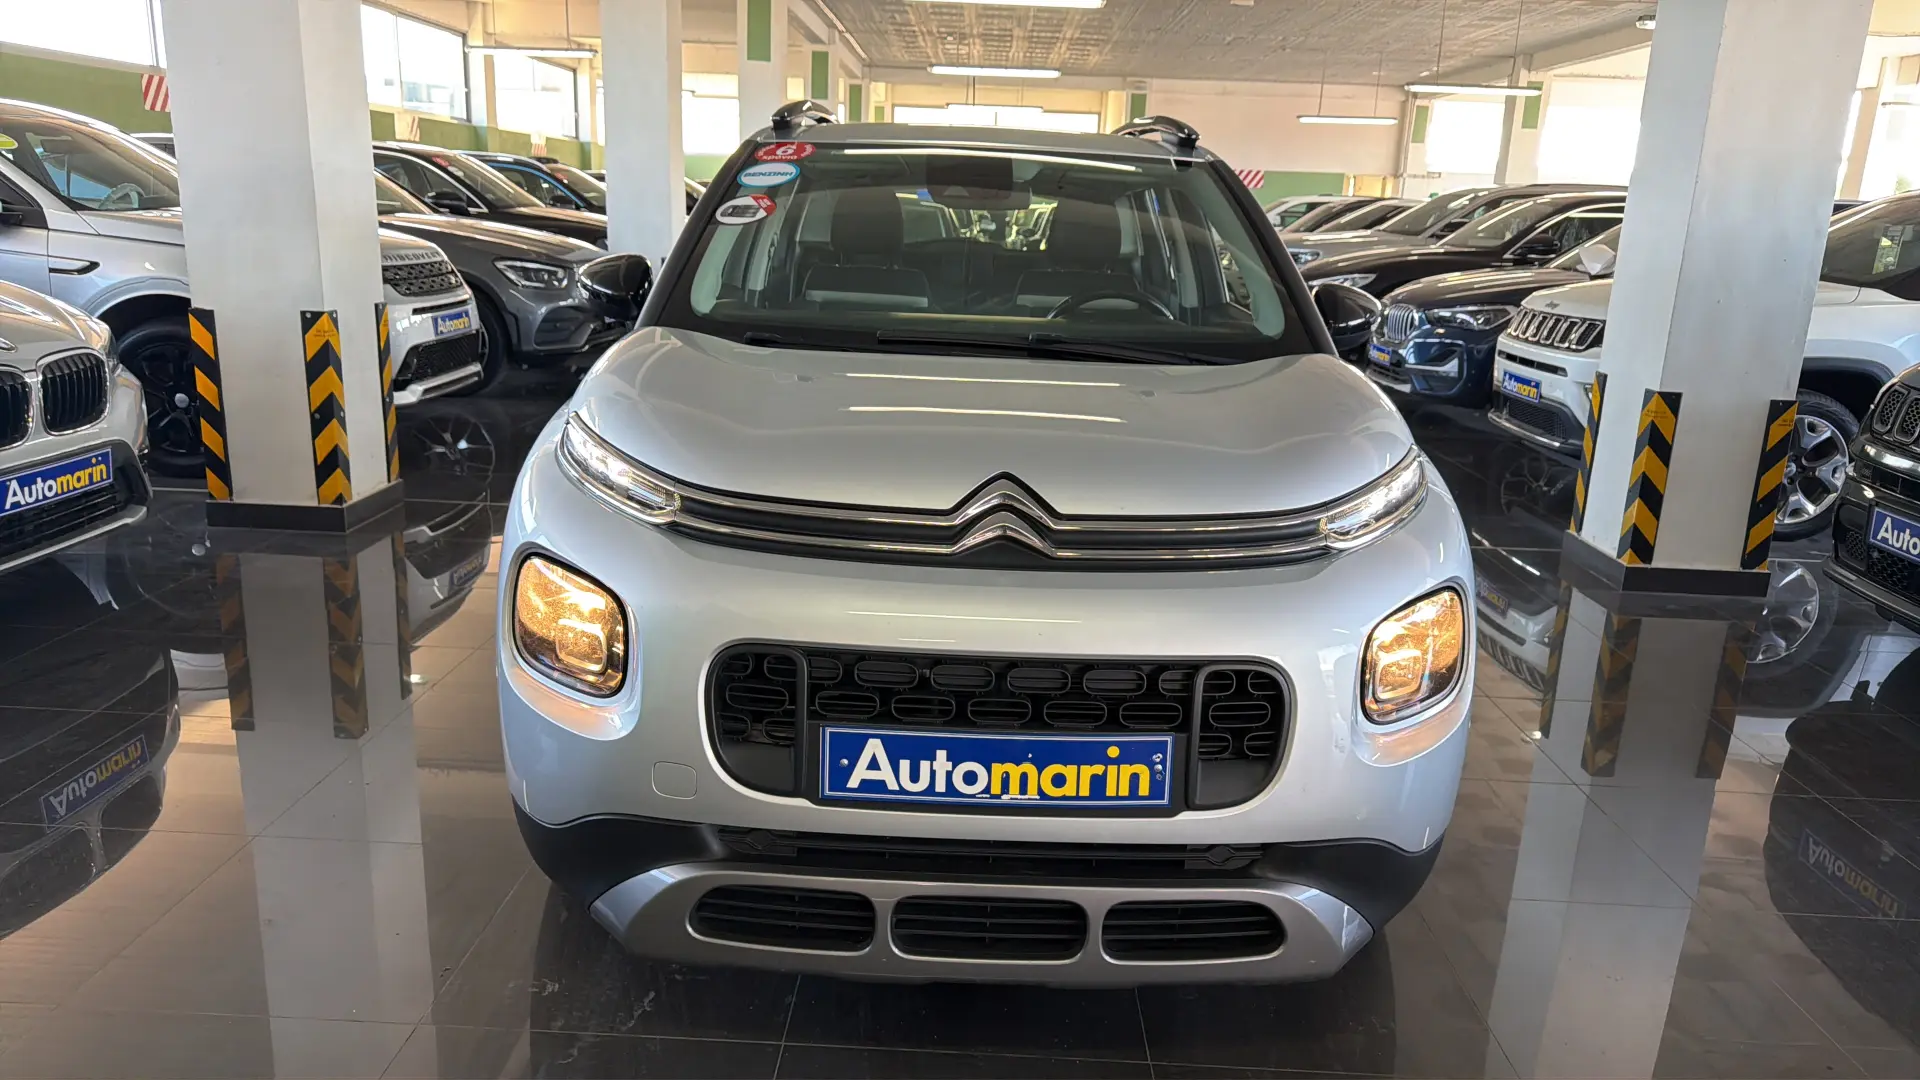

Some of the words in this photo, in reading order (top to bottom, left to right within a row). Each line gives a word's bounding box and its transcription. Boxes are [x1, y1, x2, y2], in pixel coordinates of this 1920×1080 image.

[776, 141, 797, 155] 6
[437, 312, 470, 334] Automarin
[1502, 372, 1537, 399] Automarin
[4, 457, 107, 510] Automarin
[846, 738, 1150, 797] Automarin
